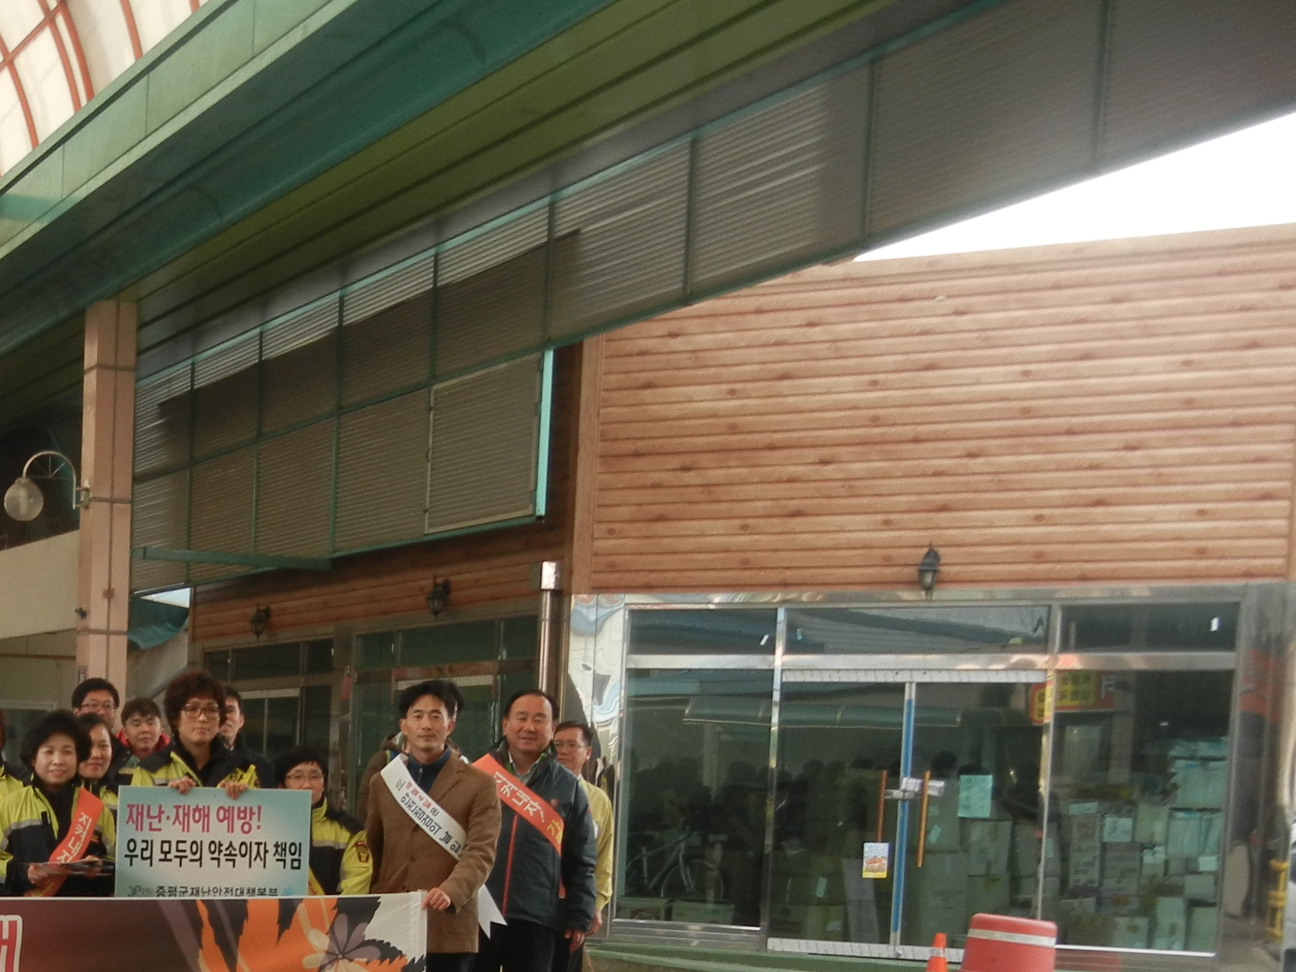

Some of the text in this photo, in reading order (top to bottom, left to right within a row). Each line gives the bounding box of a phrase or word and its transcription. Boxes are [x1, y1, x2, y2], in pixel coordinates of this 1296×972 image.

[125, 803, 262, 836] 재난·재해 예방!
[124, 837, 303, 871] 우리 모두의 약속이자 책임
